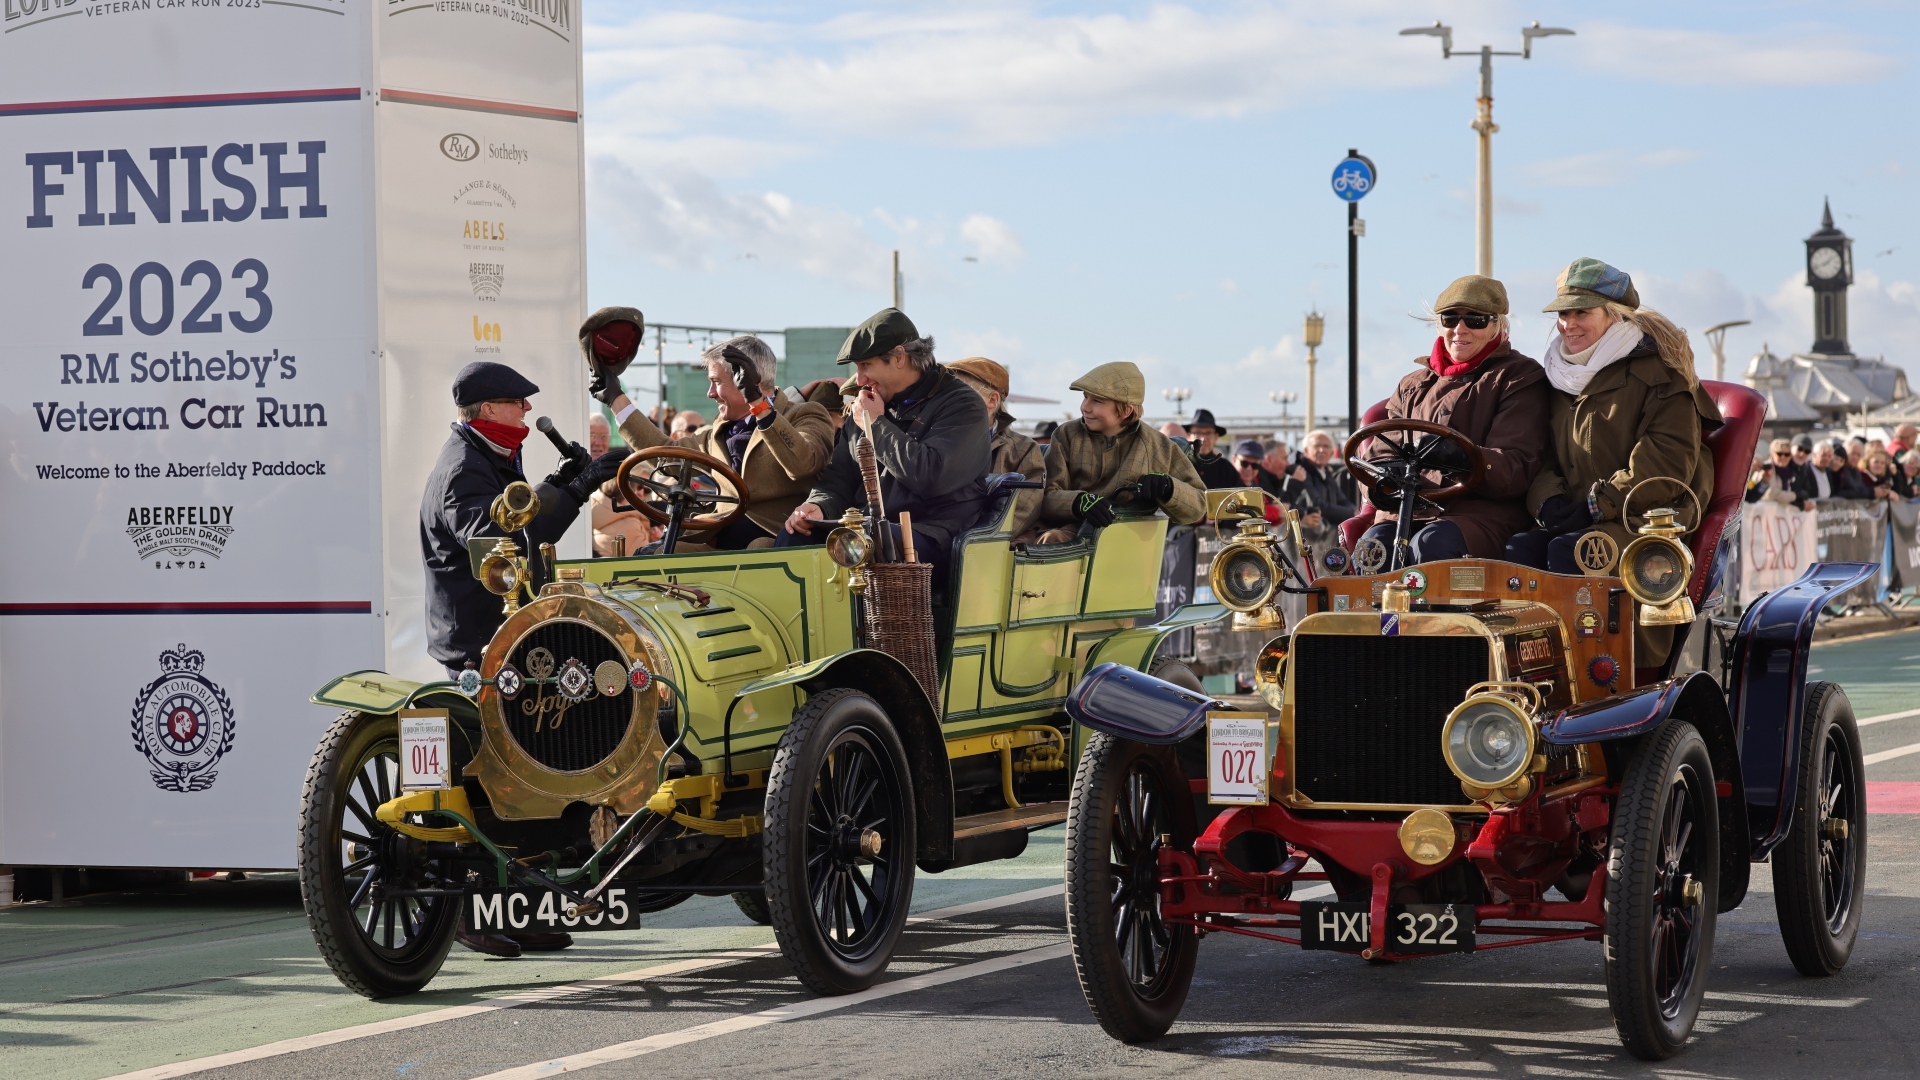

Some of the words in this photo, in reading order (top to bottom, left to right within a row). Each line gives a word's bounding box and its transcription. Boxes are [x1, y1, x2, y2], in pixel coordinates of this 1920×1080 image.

[86, 1, 150, 17] VETERAN
[157, 0, 185, 8] CAR
[227, 0, 260, 8] 2023
[435, 2, 472, 12] VETERAN
[474, 3, 491, 15] CAR
[493, 6, 509, 19] RUN
[511, 11, 529, 25] 2023
[489, 142, 528, 165] Sotheby's
[25, 140, 328, 229] FINISH
[459, 180, 484, 196] LANGE
[485, 180, 491, 190] &
[492, 182, 517, 209] SÖHNE
[463, 219, 505, 241] ABELS
[469, 262, 505, 276] ABERFELDY
[81, 257, 273, 337] 2023
[474, 345, 489, 354] Support
[60, 352, 120, 385] RM
[130, 348, 297, 388] Sotheby's
[32, 400, 170, 433] Veteran
[180, 397, 245, 430] Car
[256, 396, 328, 428] Run
[35, 464, 110, 480] Welcome
[114, 463, 130, 478] to
[134, 463, 161, 478] the
[165, 461, 247, 480] Aberfeldy
[252, 460, 326, 477] Paddock
[127, 506, 233, 525] ABERFELDY
[133, 532, 153, 547] THE
[155, 526, 196, 538] GOLDEN
[198, 529, 227, 547] DRAM
[137, 541, 158, 555] SINGLE
[159, 537, 174, 546] MALT
[174, 537, 199, 545] SCOTCH
[200, 541, 223, 555] WHISKY
[1519, 637, 1551, 661] GENEVIEVE
[150, 680, 220, 718] AUTOMOBILE
[145, 713, 163, 757] ROYAL
[203, 721, 221, 757] CLUB
[1211, 728, 1231, 738] LONDON
[1231, 728, 1239, 736] TO
[1239, 728, 1264, 739] BRIGHTON
[411, 744, 440, 775] 014
[1221, 749, 1256, 784] 027
[472, 892, 530, 930] MC
[1396, 912, 1459, 945] 322
